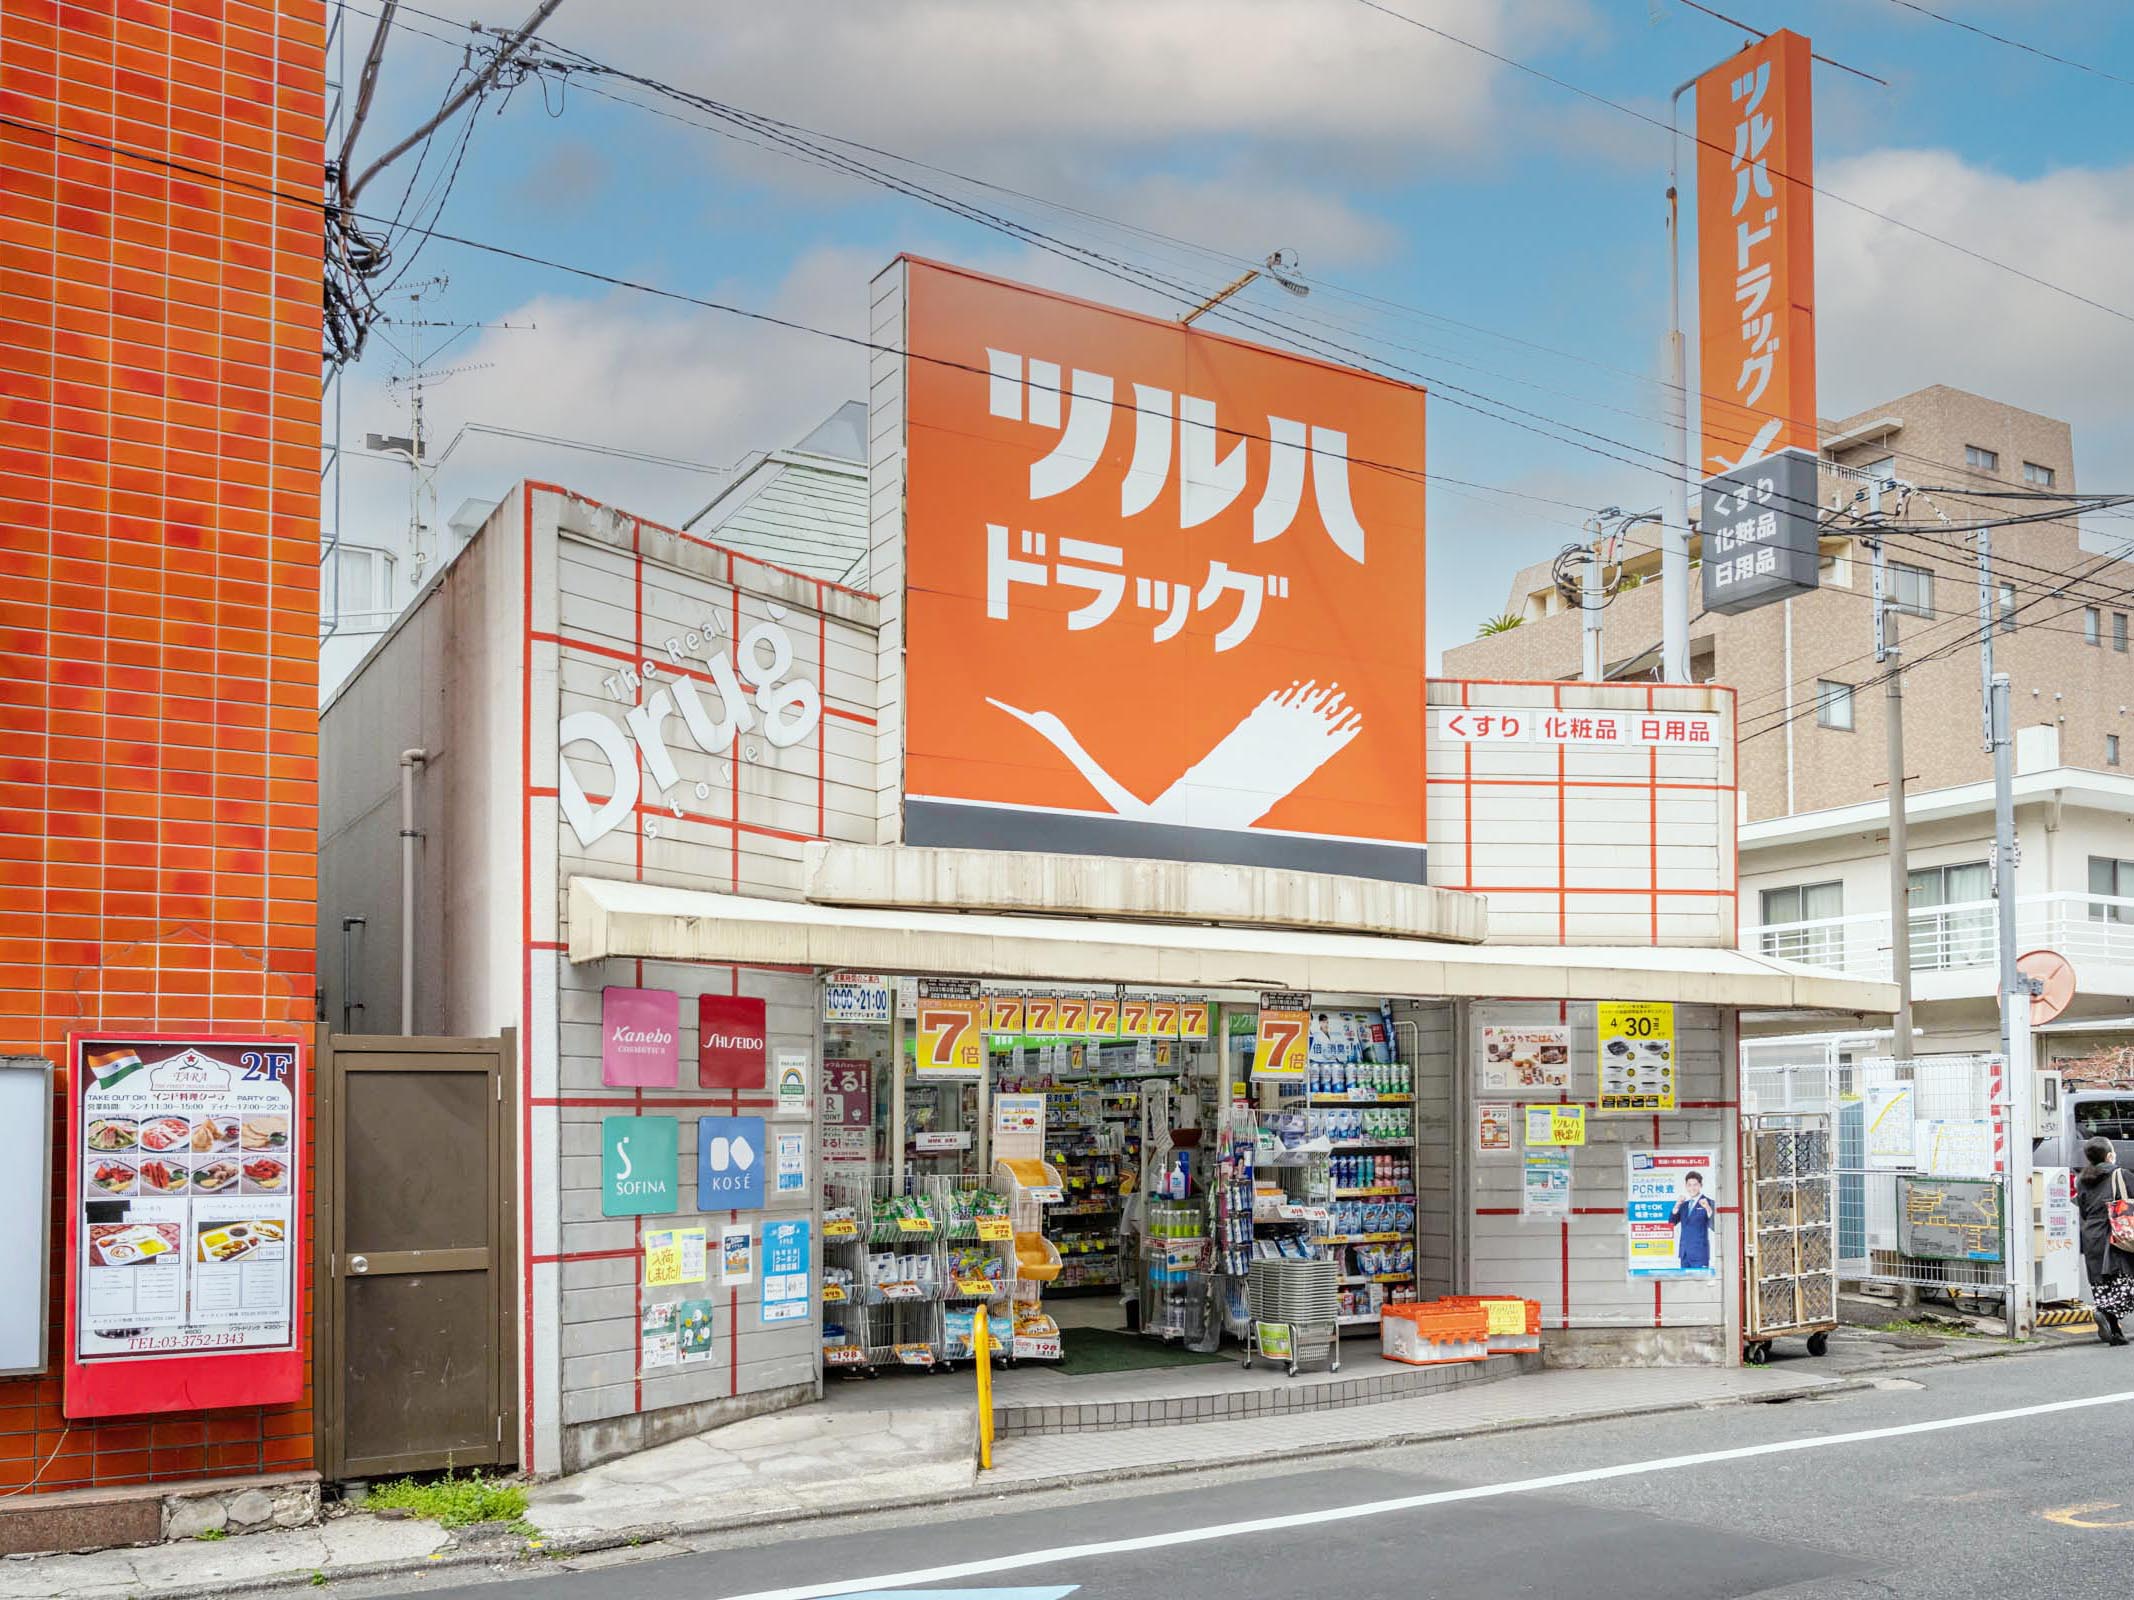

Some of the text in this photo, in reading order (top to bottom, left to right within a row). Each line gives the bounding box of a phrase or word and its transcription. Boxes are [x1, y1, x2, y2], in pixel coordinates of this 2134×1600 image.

[1731, 61, 1779, 407] ツルハドラッグ
[985, 347, 1365, 564] ツルハ
[1714, 478, 1774, 516] くすり
[1715, 511, 1776, 553] 化粧品
[1715, 547, 1776, 587] 日用品
[986, 523, 1288, 652] ドラッグ
[602, 608, 727, 700] The Real
[559, 600, 821, 849] Drug
[1448, 714, 1710, 742] くすり 化粧品 日用品
[613, 1026, 672, 1044] Kanebo
[703, 1034, 763, 1050] SHISEIDO
[241, 1052, 292, 1081] 2F
[616, 1180, 666, 1195] SOFINA
[713, 1173, 751, 1190] KOSÉ
[128, 1333, 245, 1351] TEL:03-3752-1343
